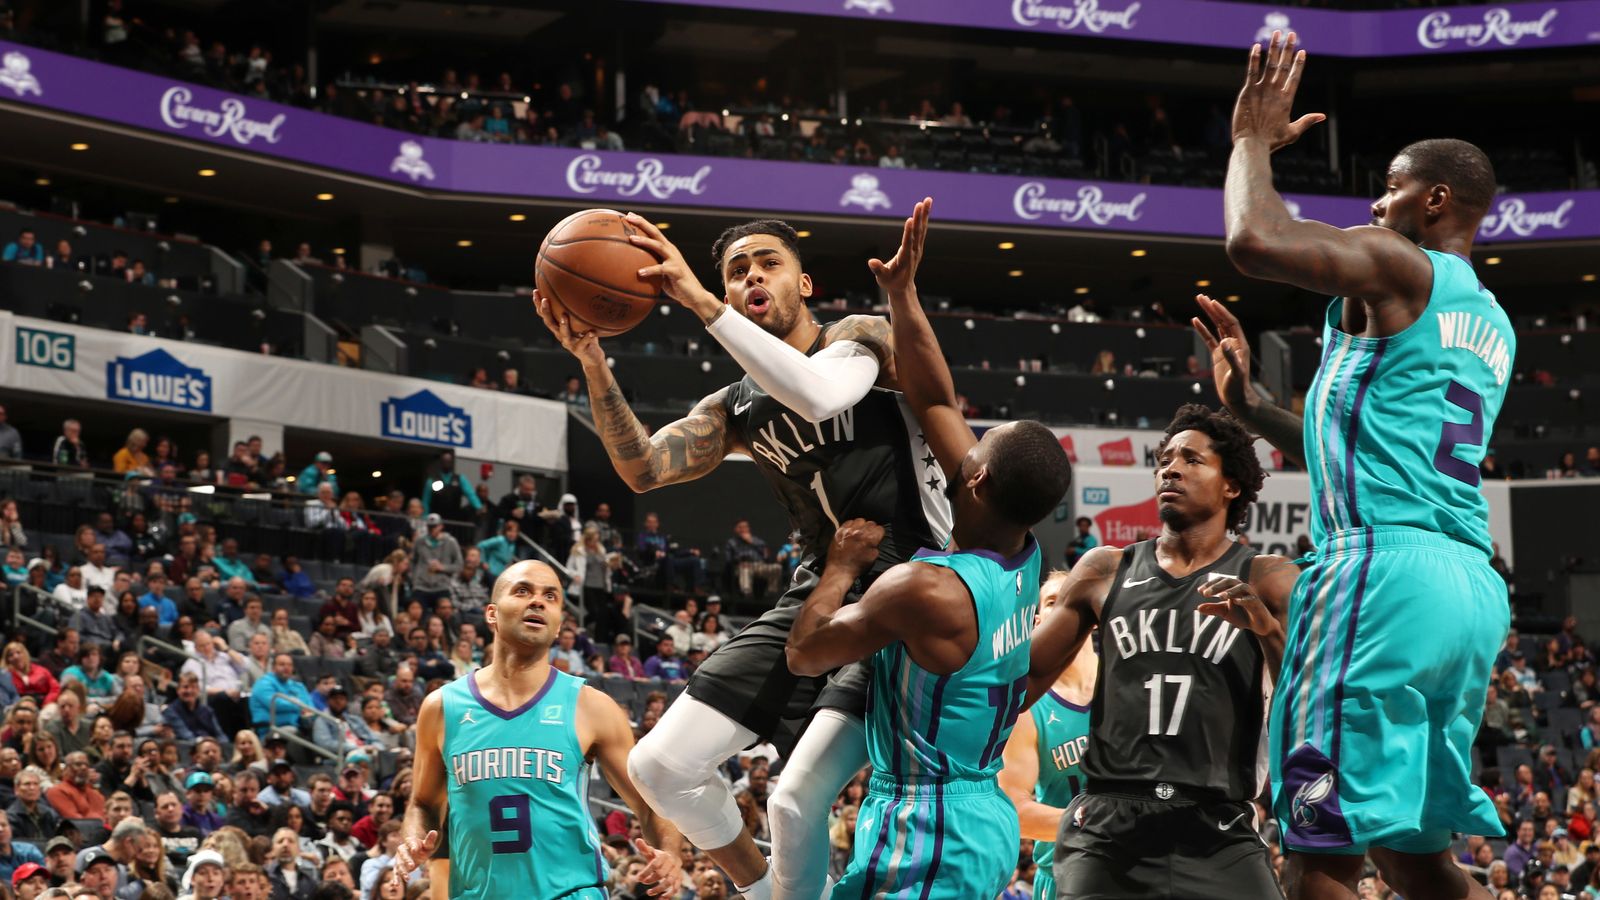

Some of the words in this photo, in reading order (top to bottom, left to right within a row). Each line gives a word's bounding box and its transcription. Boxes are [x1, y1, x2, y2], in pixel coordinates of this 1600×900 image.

[1417, 11, 1483, 49] Crown
[1466, 8, 1558, 46] Royal
[160, 86, 220, 129] Crown
[204, 98, 286, 145] Royal
[566, 154, 635, 194] Crown
[617, 158, 712, 199] Royal
[1013, 182, 1077, 220] Crown
[1060, 185, 1147, 225] Royal
[1480, 198, 1574, 237] Royal
[19, 332, 71, 368] 106
[1437, 312, 1510, 386] WILLIAMS
[116, 364, 206, 408] LOWE'S
[388, 403, 466, 444] LOWE'S
[1433, 379, 1484, 488] 2
[810, 471, 840, 530] 1
[1109, 609, 1240, 664] BKLYN
[1144, 674, 1194, 736] 17
[453, 747, 565, 787] HORNETS
[488, 793, 533, 855] 9
